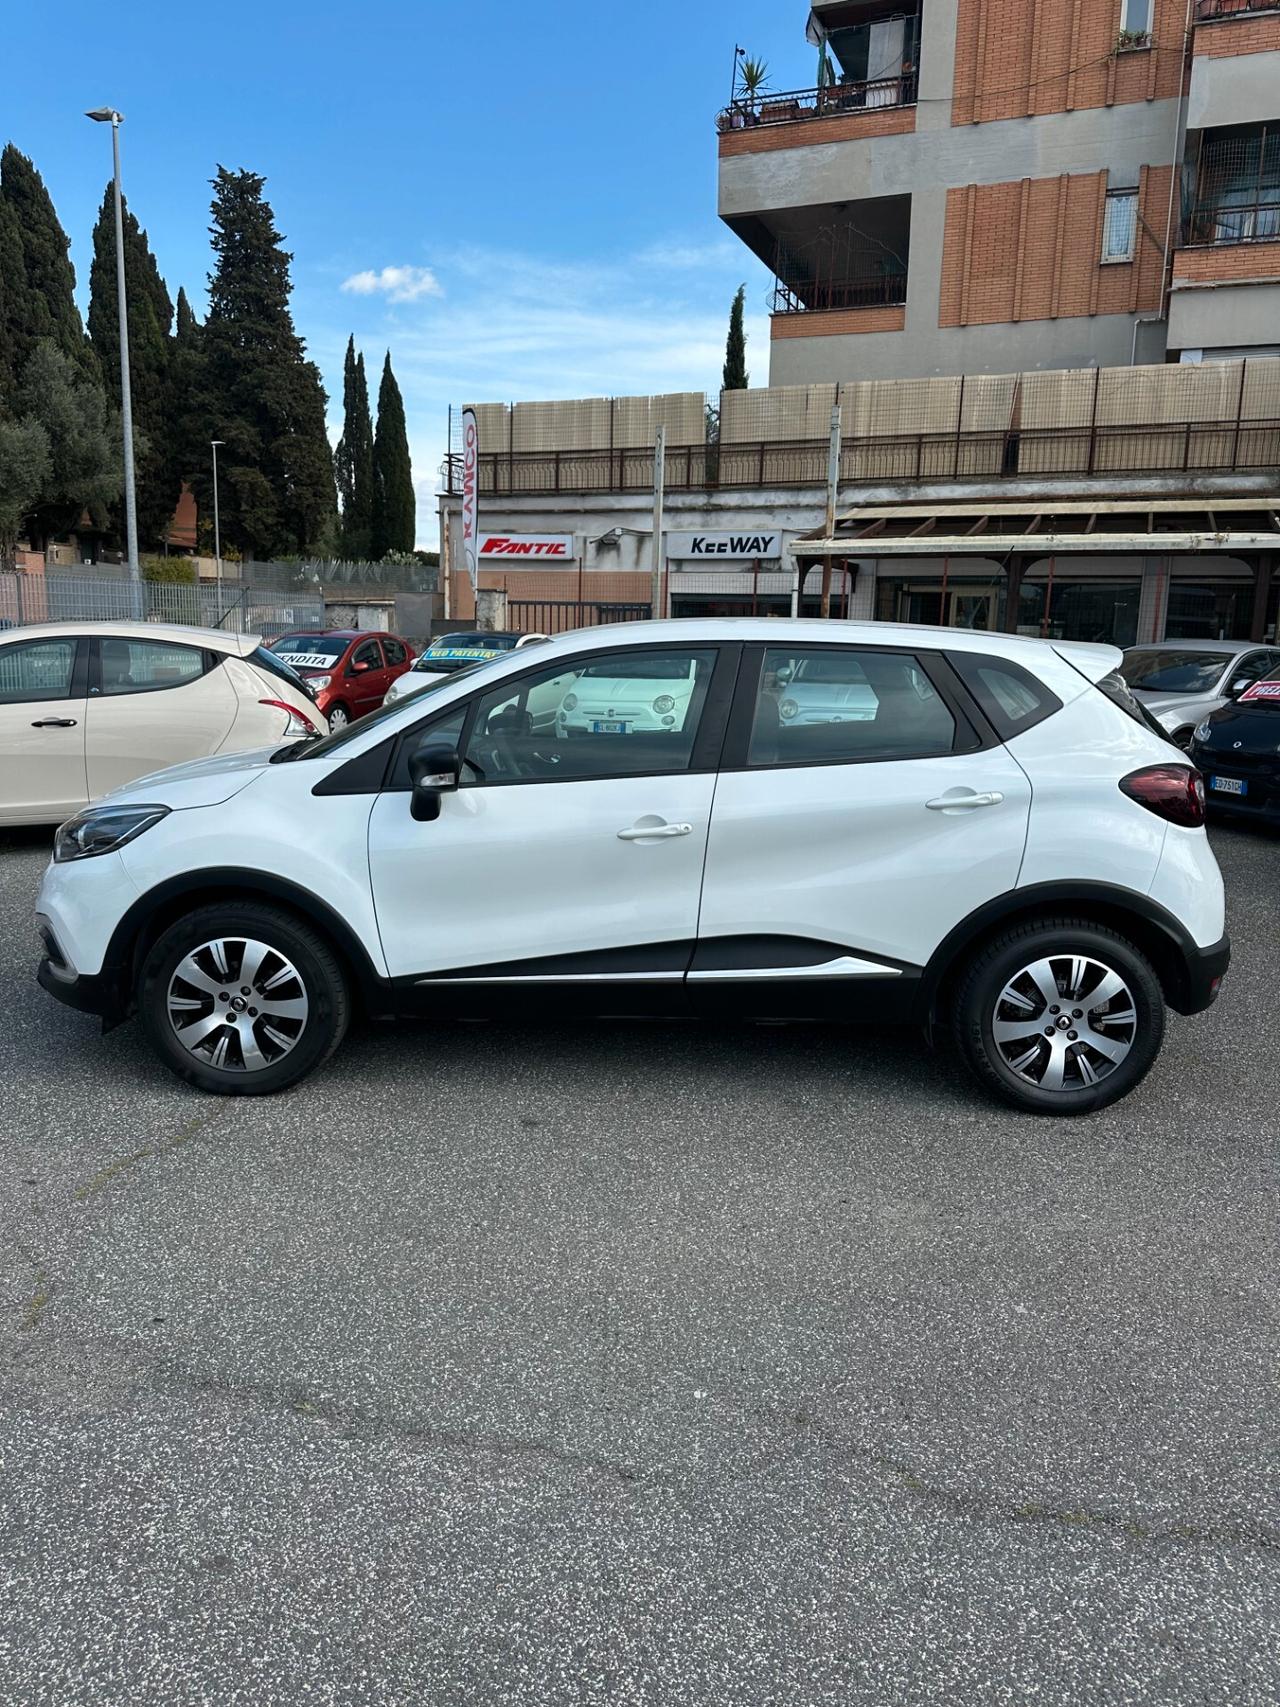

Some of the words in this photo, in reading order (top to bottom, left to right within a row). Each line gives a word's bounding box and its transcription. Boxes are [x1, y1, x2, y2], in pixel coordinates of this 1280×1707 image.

[480, 538, 567, 555] FANTIC
[691, 535, 775, 554] KEEWAY
[278, 655, 328, 666] ENDITA
[430, 650, 449, 658] NEO
